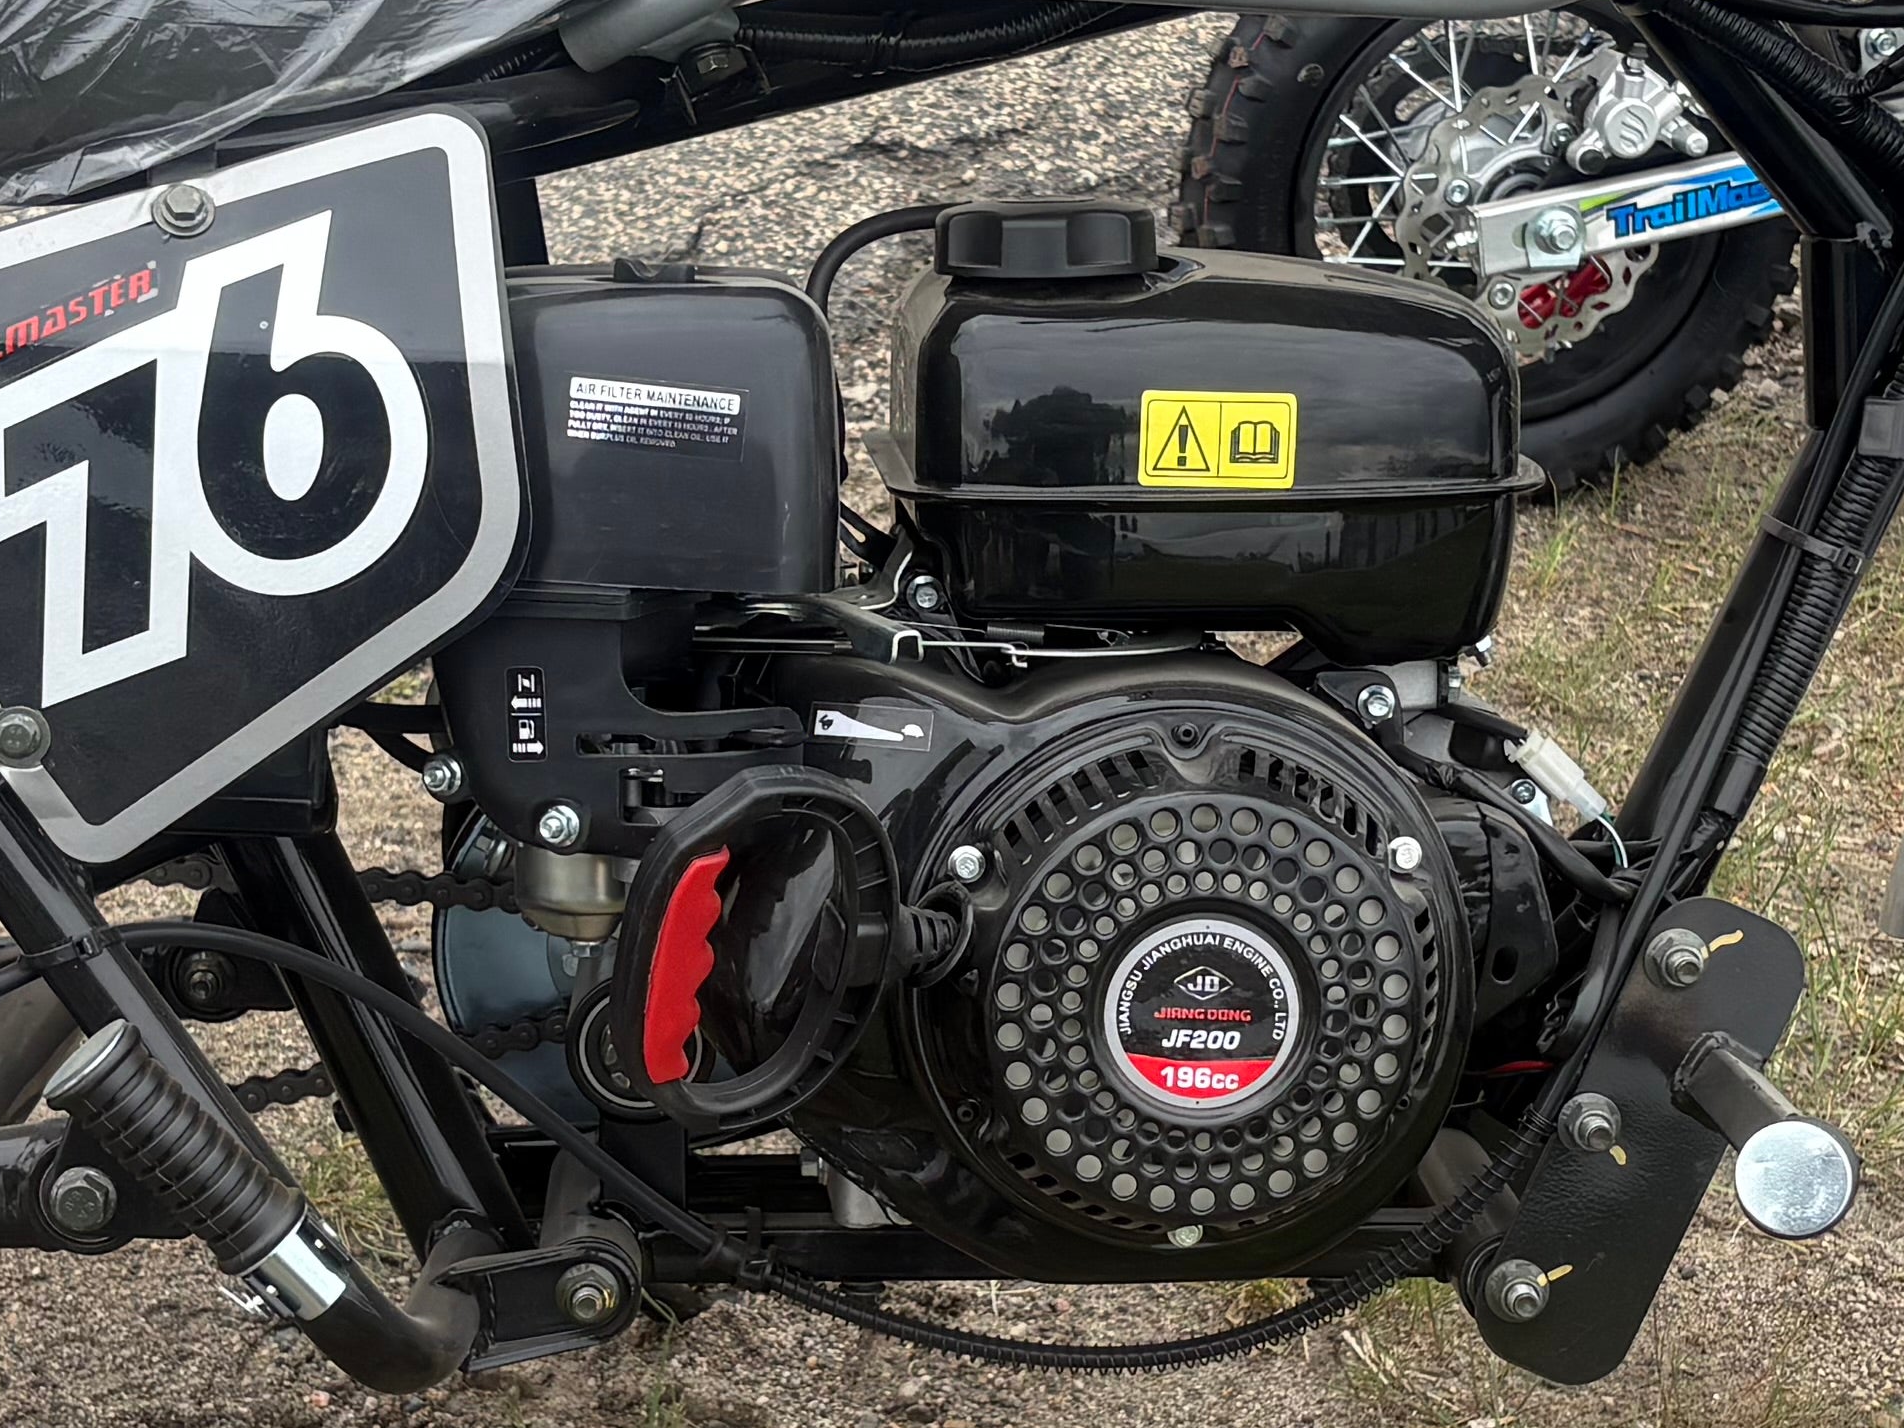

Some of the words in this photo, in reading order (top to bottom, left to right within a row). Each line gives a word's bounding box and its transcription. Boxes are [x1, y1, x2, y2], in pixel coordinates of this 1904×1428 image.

[576, 383, 596, 395] AIR
[600, 385, 642, 401] FILTER
[647, 390, 735, 411] MAINTENANCE
[1118, 971, 1142, 1035] JIANGSU
[1143, 934, 1220, 971] JIANGHUAI
[1223, 937, 1274, 977] ENGINE
[1272, 1012, 1287, 1040] LTD
[1187, 975, 1220, 991] JD
[1161, 1029, 1241, 1050] JF200
[1160, 1066, 1239, 1089] 196cc
